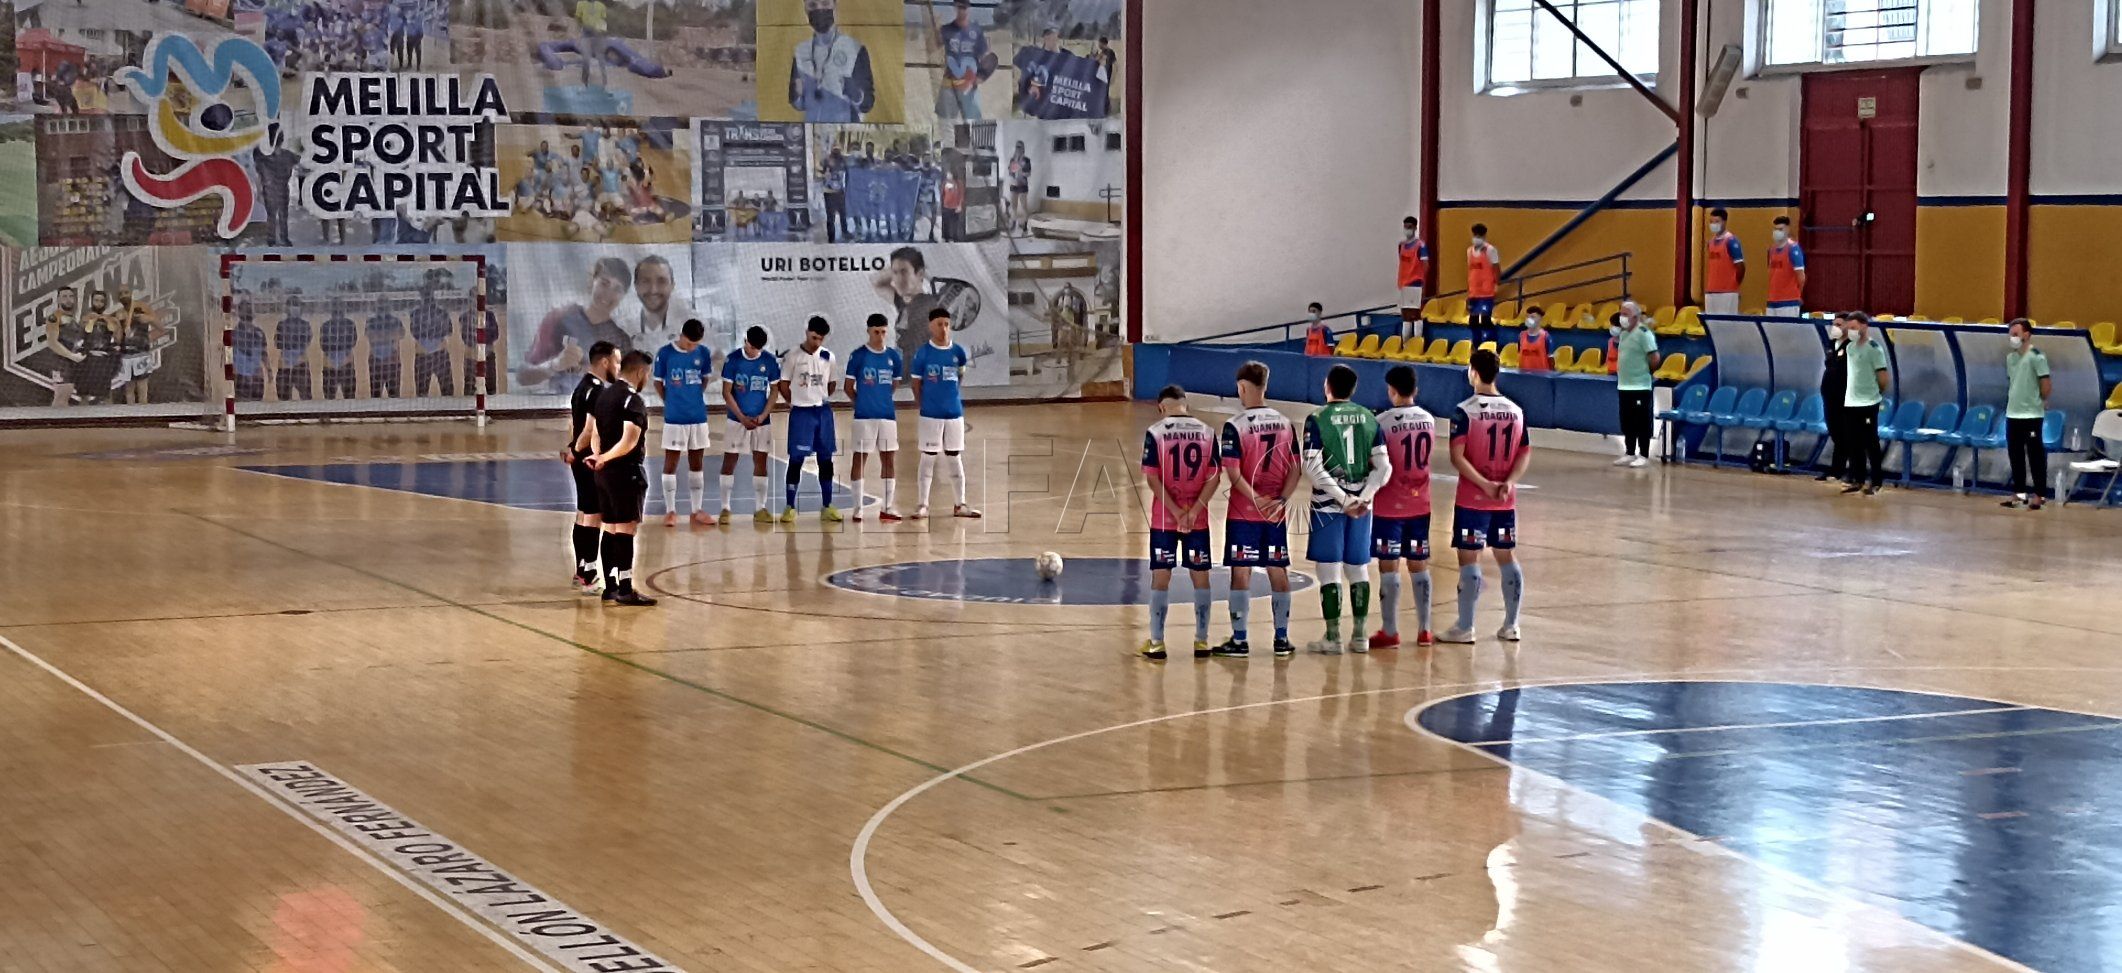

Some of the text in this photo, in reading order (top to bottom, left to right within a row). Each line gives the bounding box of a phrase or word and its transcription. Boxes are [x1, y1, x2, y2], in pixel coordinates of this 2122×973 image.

[309, 76, 509, 117] MELILLA
[1050, 95, 1088, 112] CAPITAL
[1053, 75, 1091, 93] MELILLA
[311, 123, 473, 165] SPORT
[311, 170, 511, 212] CAPITAL
[761, 257, 886, 272] URI BOTELLO
[1163, 431, 1207, 441] MANUEL
[1249, 421, 1286, 435] JUANMA
[1330, 414, 1367, 425] SERGIO
[1168, 442, 1203, 482] 19
[1260, 433, 1277, 473] 7
[1342, 424, 1355, 465] 1
[1400, 431, 1432, 471] 10
[1487, 422, 1514, 462] 11
[258, 764, 429, 841] FERNÁNDEZ
[394, 841, 547, 908] LÁZARO
